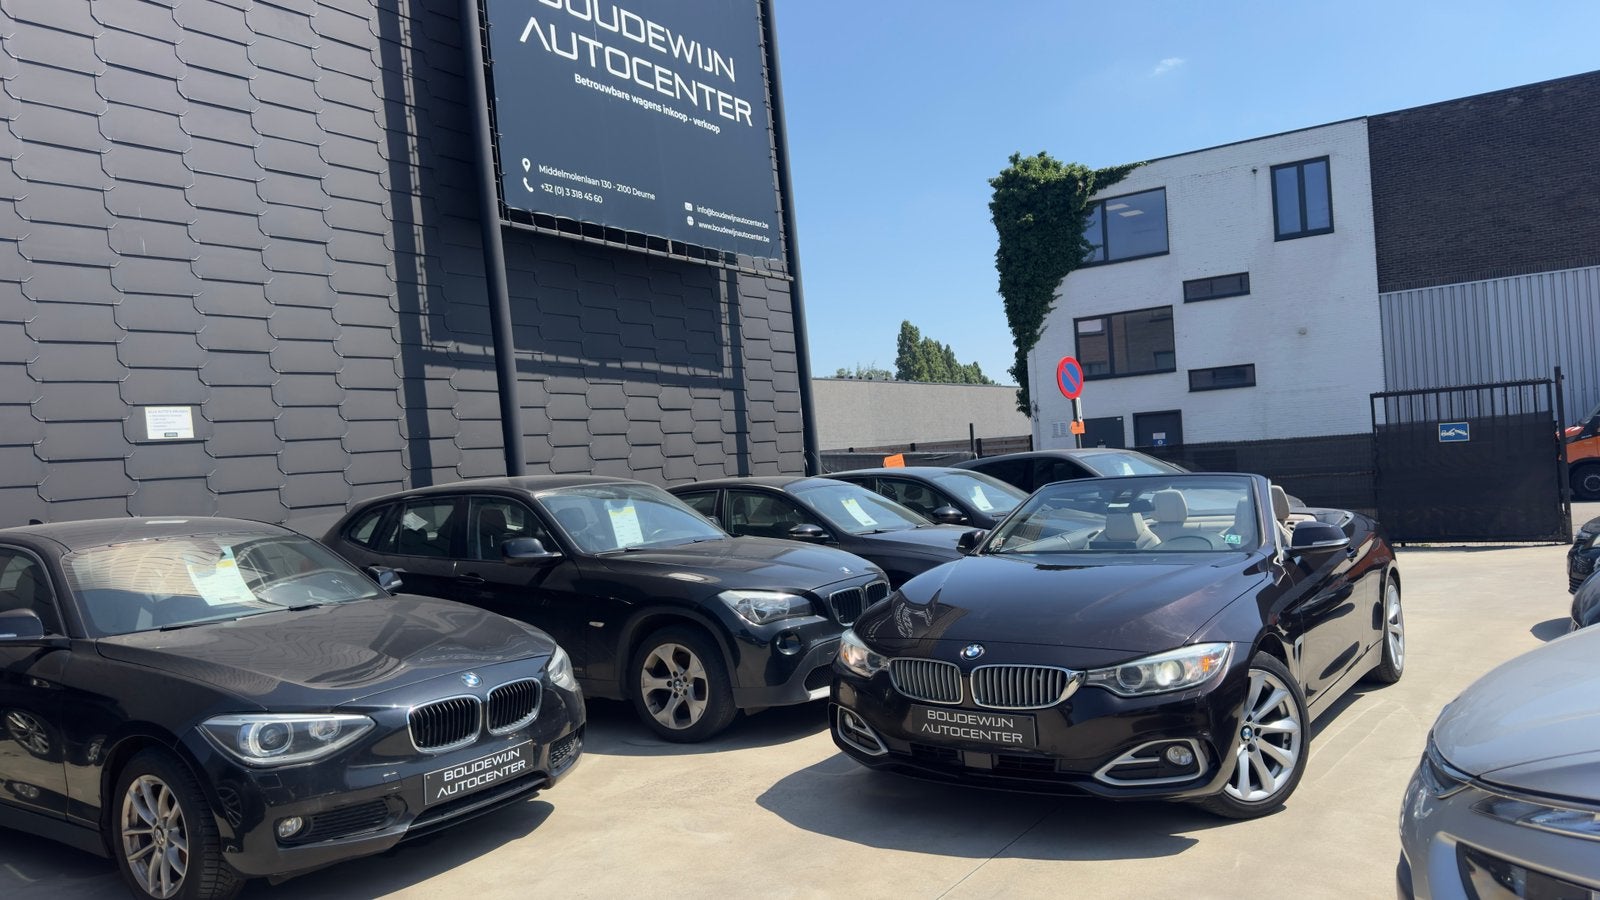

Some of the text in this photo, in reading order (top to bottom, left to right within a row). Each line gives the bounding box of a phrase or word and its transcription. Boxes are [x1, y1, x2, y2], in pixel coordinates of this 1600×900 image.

[538, 0, 736, 83] OUDEWIJN
[519, 16, 753, 127] AUTOCENTER
[574, 73, 630, 101] Betrouwbare
[631, 94, 662, 112] wagens
[662, 103, 688, 123] inkoop
[693, 117, 721, 134] verkoop
[538, 164, 600, 187] Middelmolenlaan
[600, 179, 612, 190] 130
[616, 183, 632, 195] 2100
[632, 187, 656, 201] Deurne
[540, 183, 603, 204] +32 (0) 3 318 45 60
[696, 204, 769, 230] info@boudewijnautocenter.be
[697, 221, 770, 243] www.boudewijnautocenter.be
[921, 723, 1023, 744] AUTOCENTER
[927, 709, 1014, 729] BOUDEWIJN
[436, 759, 526, 799] AUTOCENTER
[443, 747, 520, 782] BOUDEWIJN
